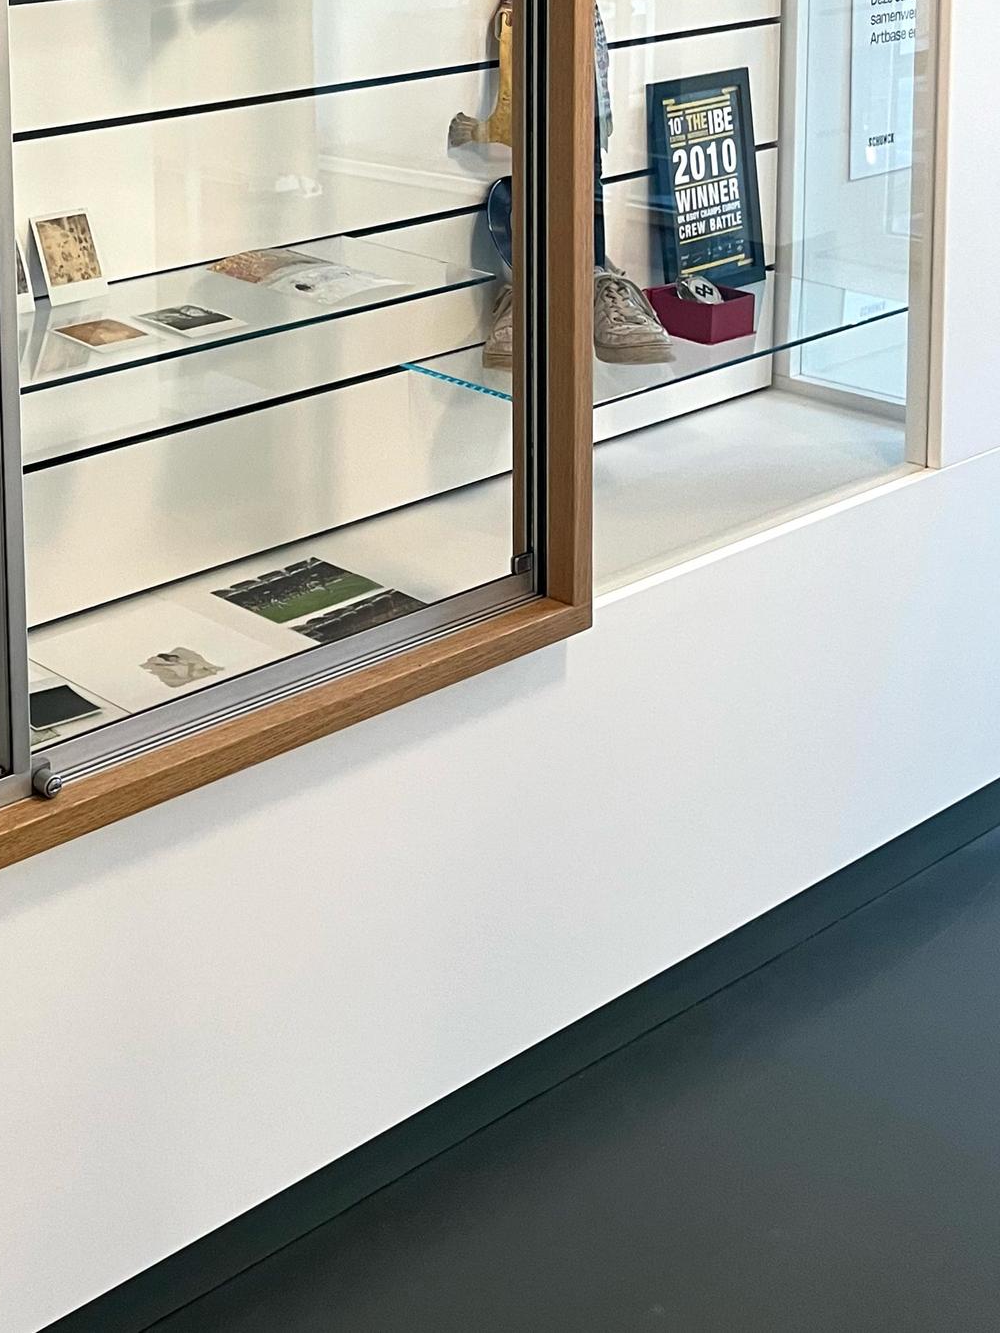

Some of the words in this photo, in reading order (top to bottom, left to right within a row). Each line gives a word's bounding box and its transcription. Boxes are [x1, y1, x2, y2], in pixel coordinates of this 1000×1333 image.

[870, 29, 907, 45] Artbase
[686, 113, 708, 133] THE
[708, 106, 734, 135] IBE
[672, 137, 738, 186] 2010
[675, 177, 740, 214] WINNER
[678, 220, 706, 240] CREW
[709, 210, 743, 232] BATTLE
